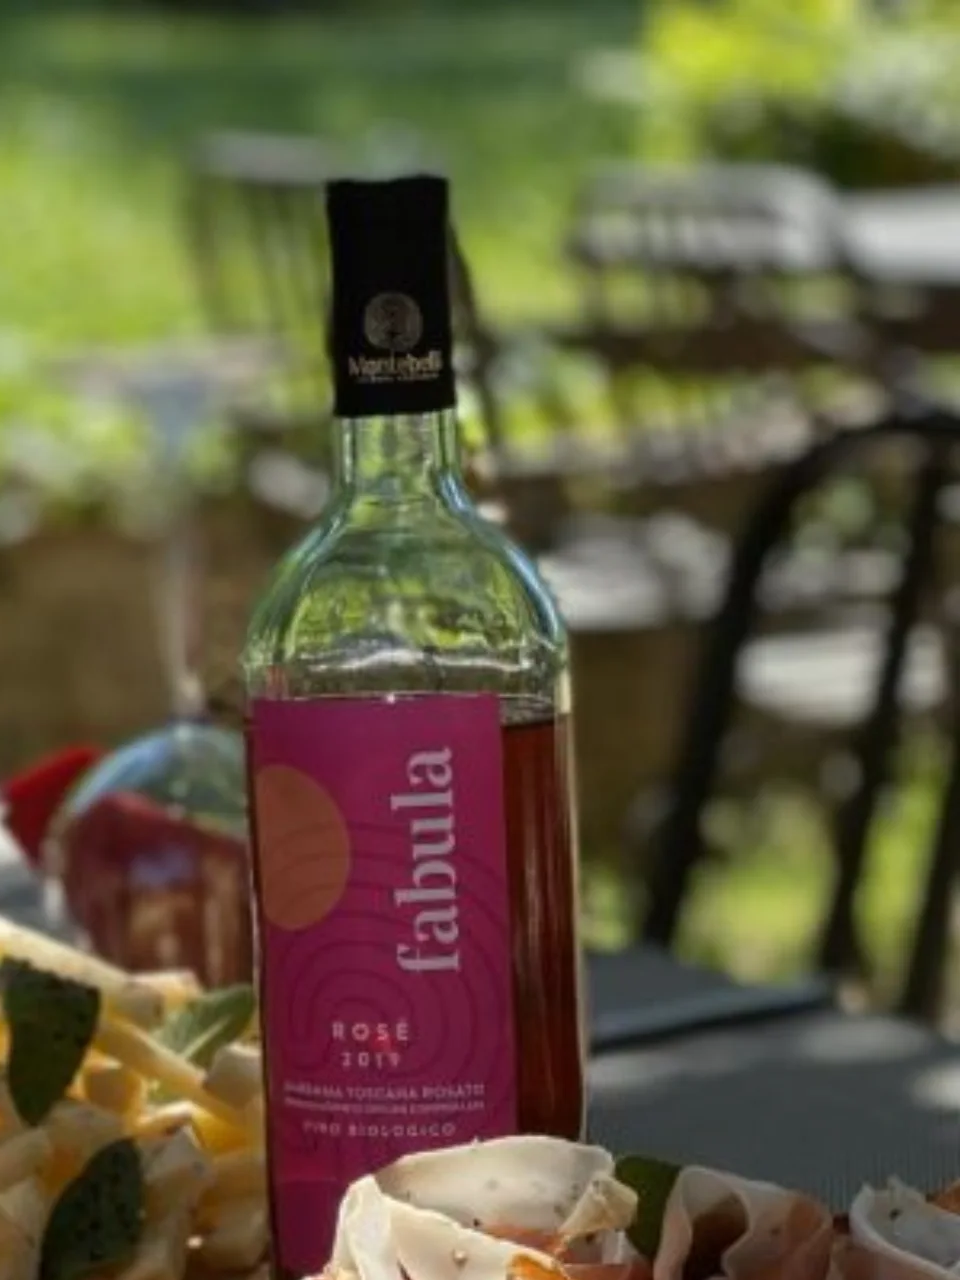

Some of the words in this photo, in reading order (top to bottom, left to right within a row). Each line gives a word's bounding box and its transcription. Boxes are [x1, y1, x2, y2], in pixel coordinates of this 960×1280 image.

[390, 746, 460, 973] fabula
[332, 1017, 410, 1042] ROSÉ
[341, 1052, 401, 1068] 2019
